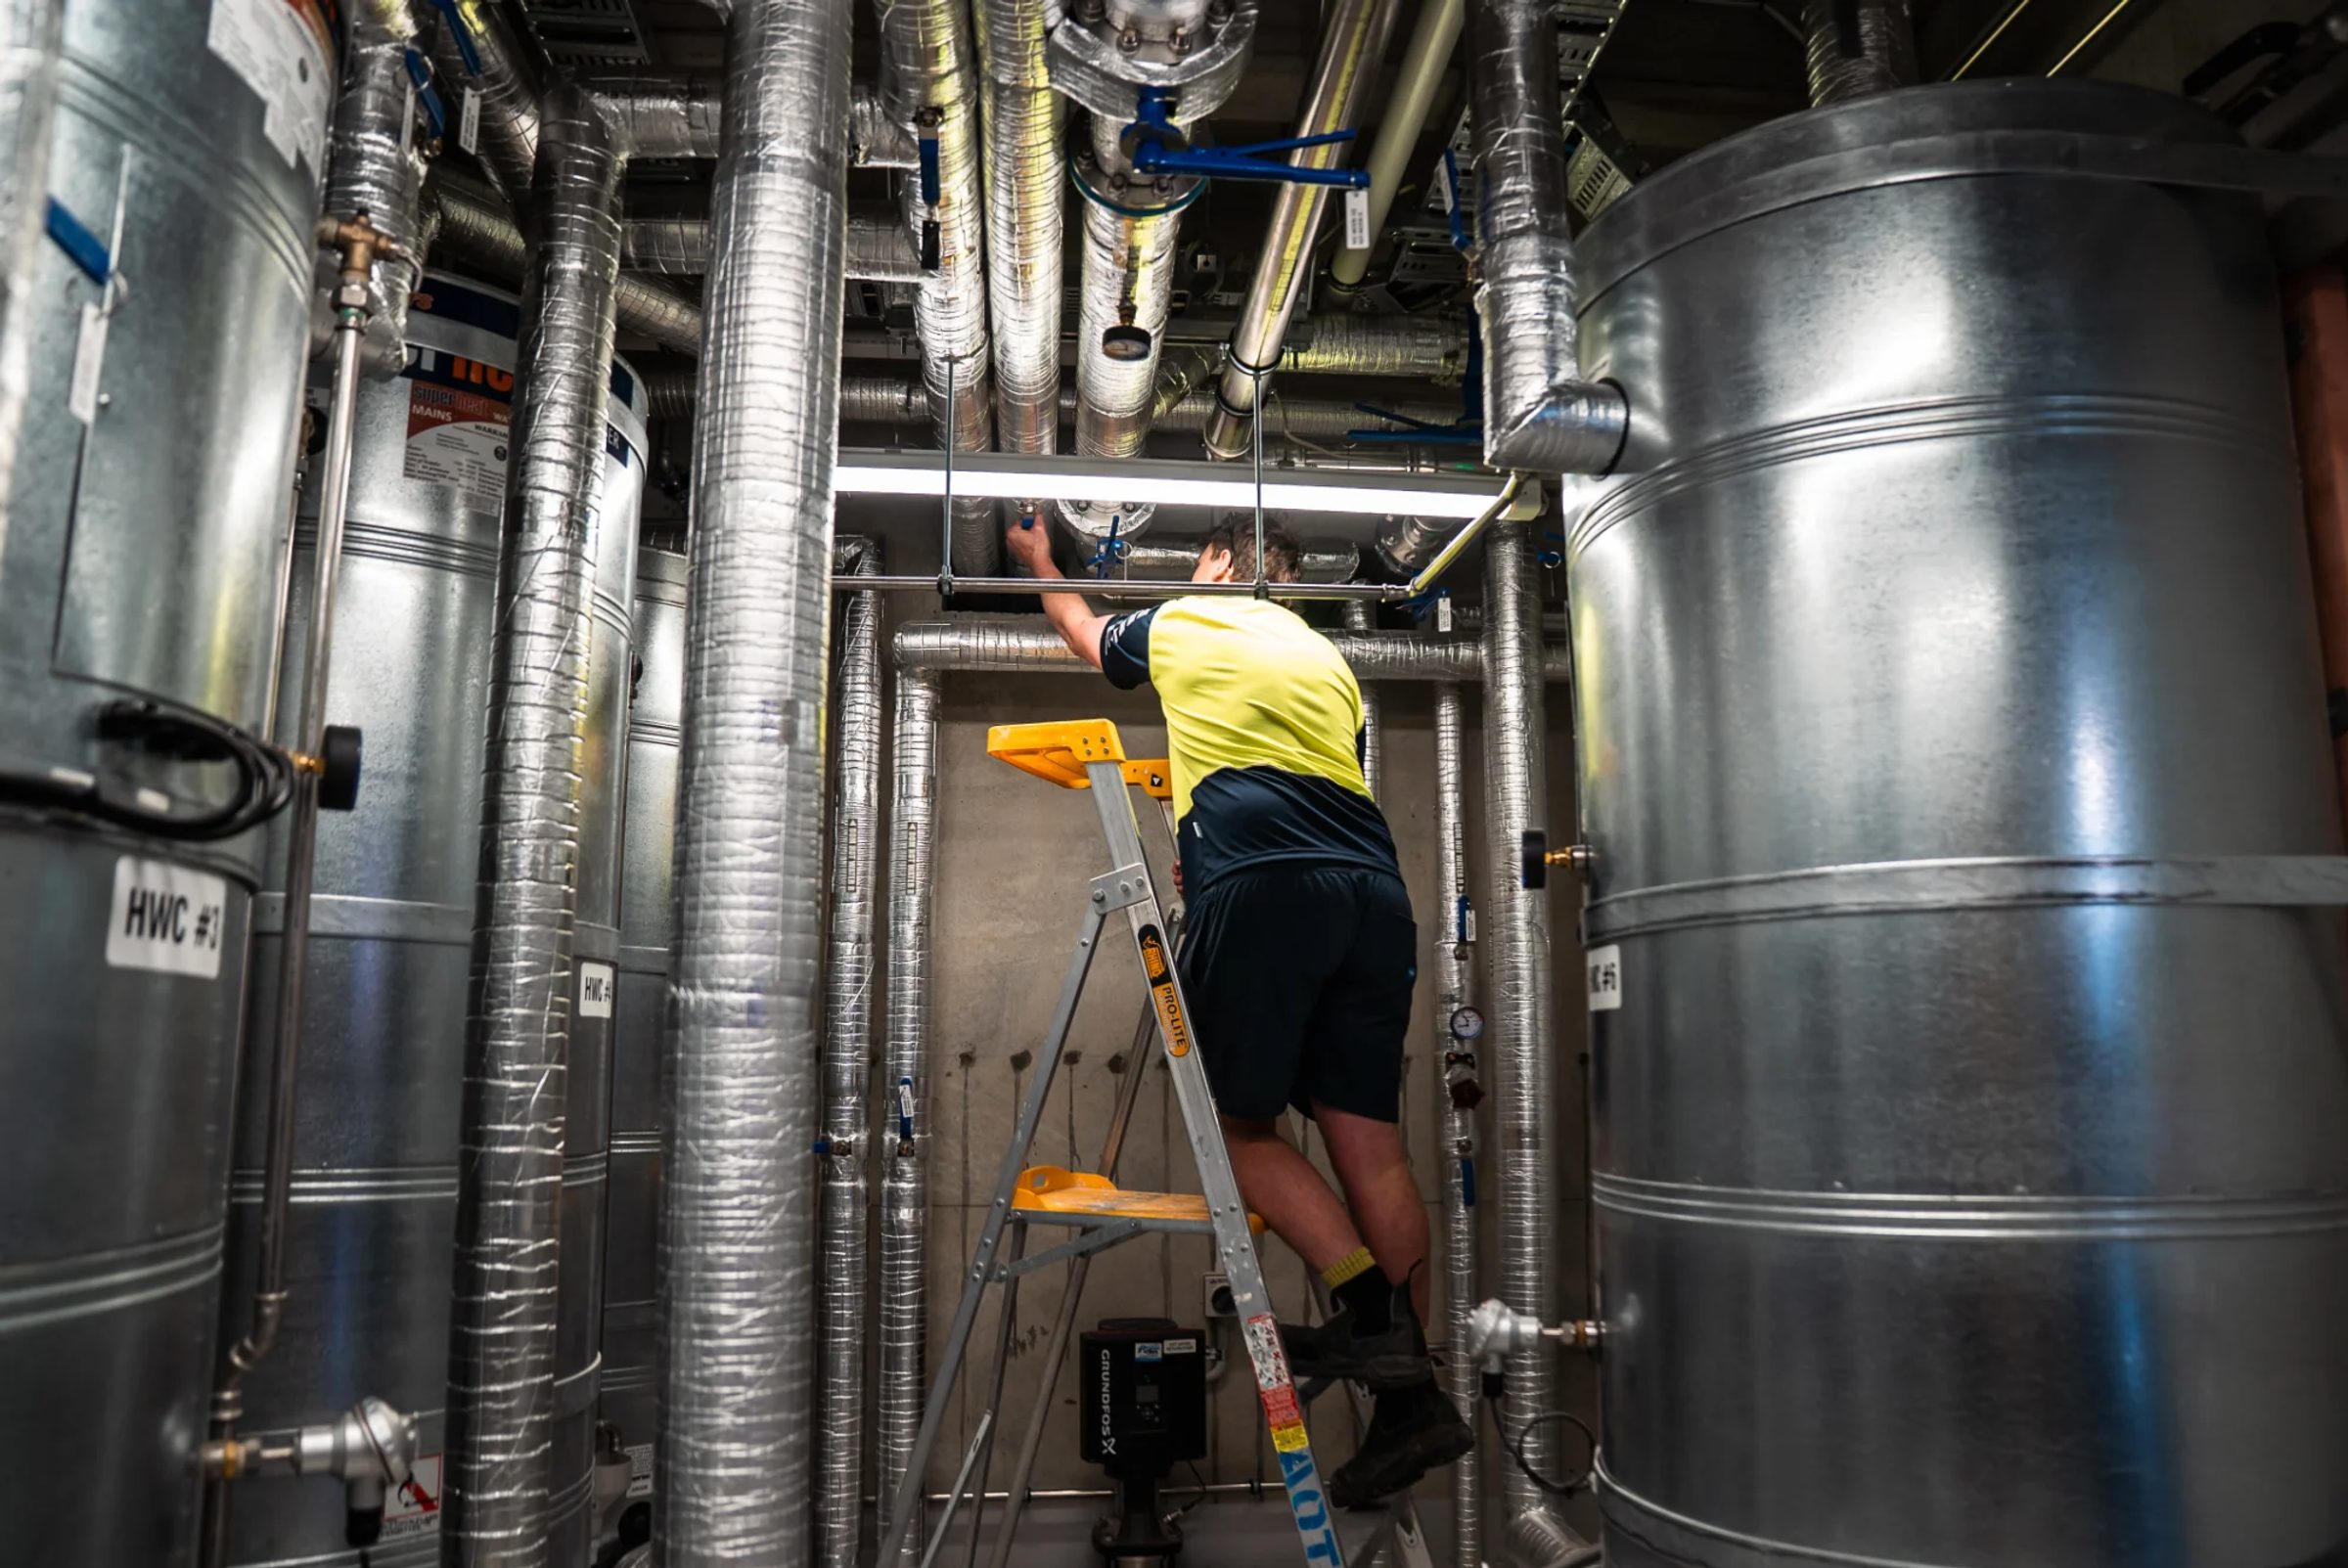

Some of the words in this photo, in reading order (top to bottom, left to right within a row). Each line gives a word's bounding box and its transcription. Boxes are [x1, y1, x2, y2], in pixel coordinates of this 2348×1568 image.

[412, 405, 453, 423] MAINS
[125, 886, 188, 945] HWC
[584, 975, 603, 1003] HWC
[1162, 985, 1187, 1048] PRO-LITE
[1101, 1349, 1111, 1437] GRUNDFOS
